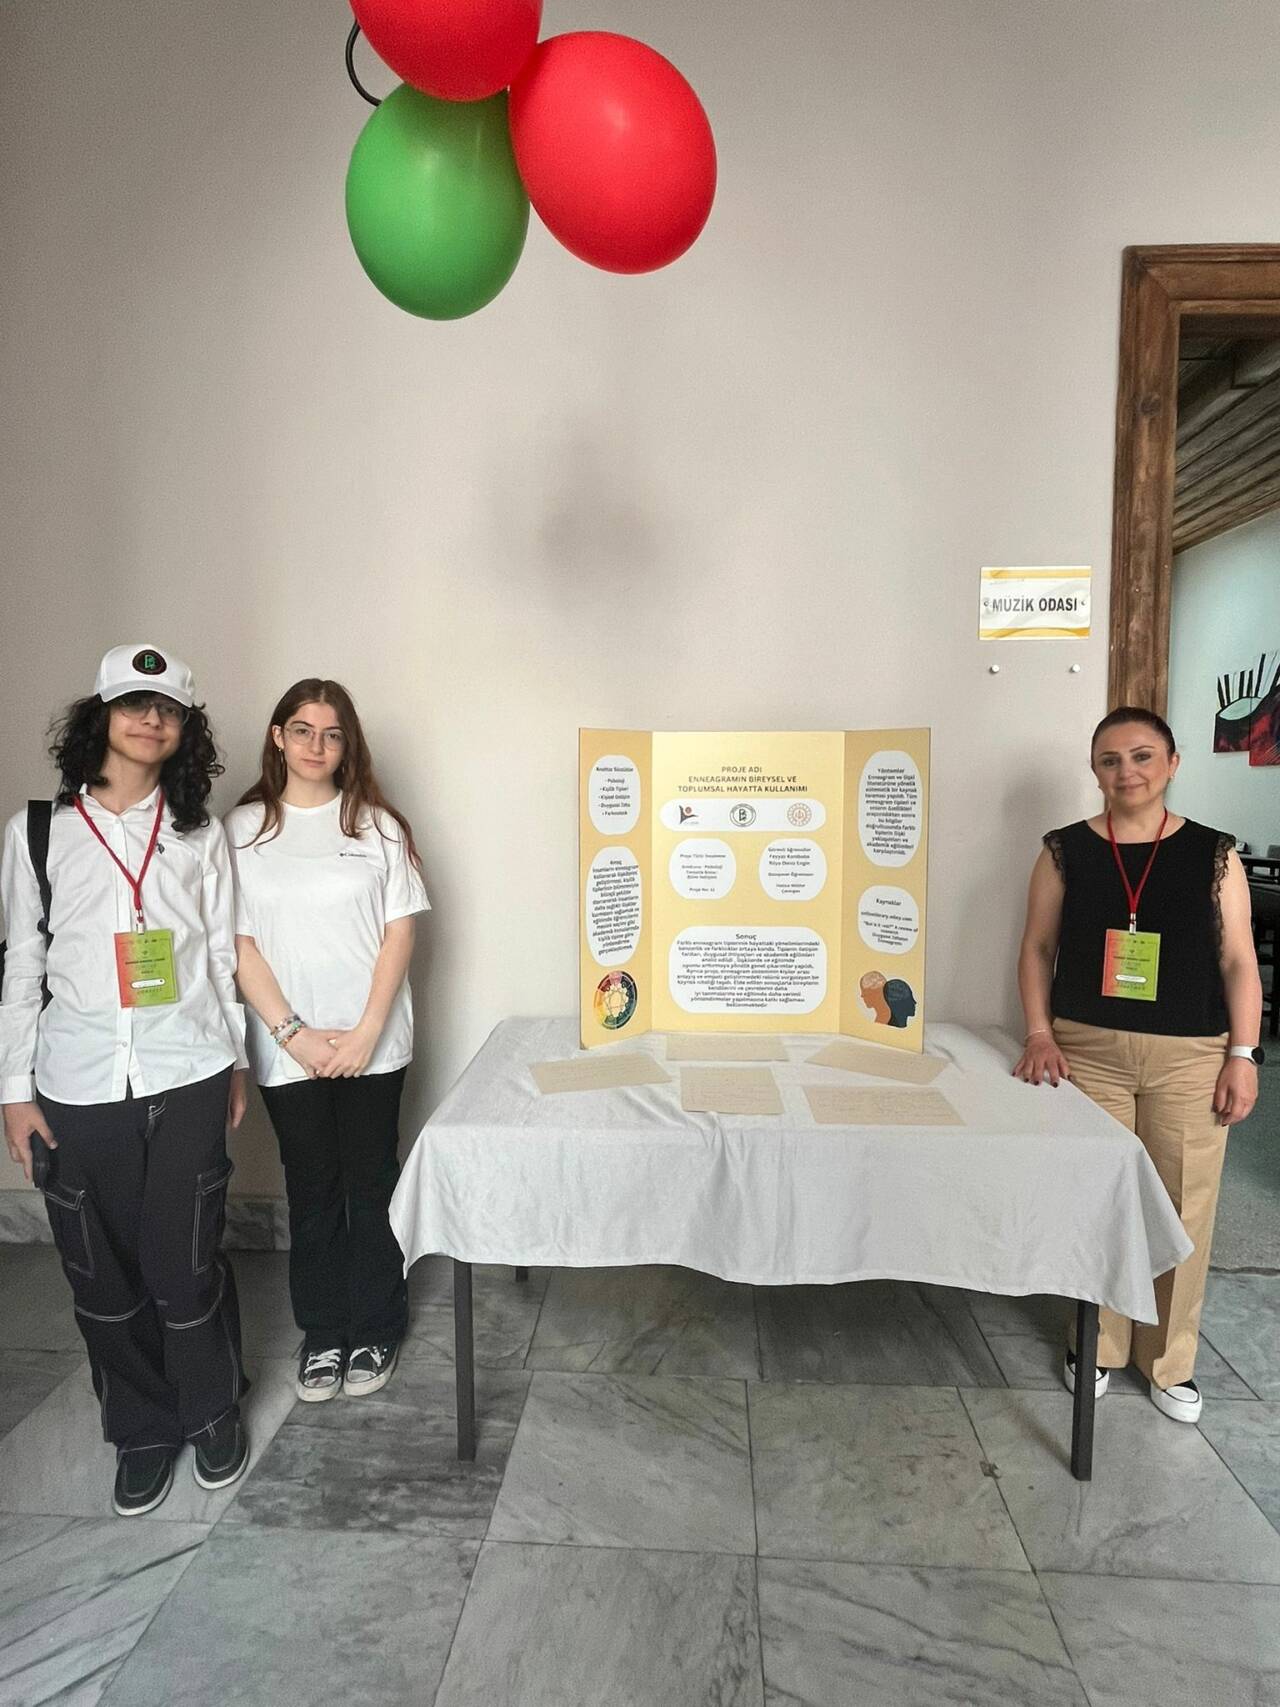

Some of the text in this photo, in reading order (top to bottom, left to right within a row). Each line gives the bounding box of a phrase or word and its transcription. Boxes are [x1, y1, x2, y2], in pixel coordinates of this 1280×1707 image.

[1038, 597, 1078, 612] ODASI
[688, 774, 797, 783] ENNEAGRAMIN BİREYSEL VE
[678, 785, 807, 793] TOPLUMSAL HAYATTA KULLANIMI
